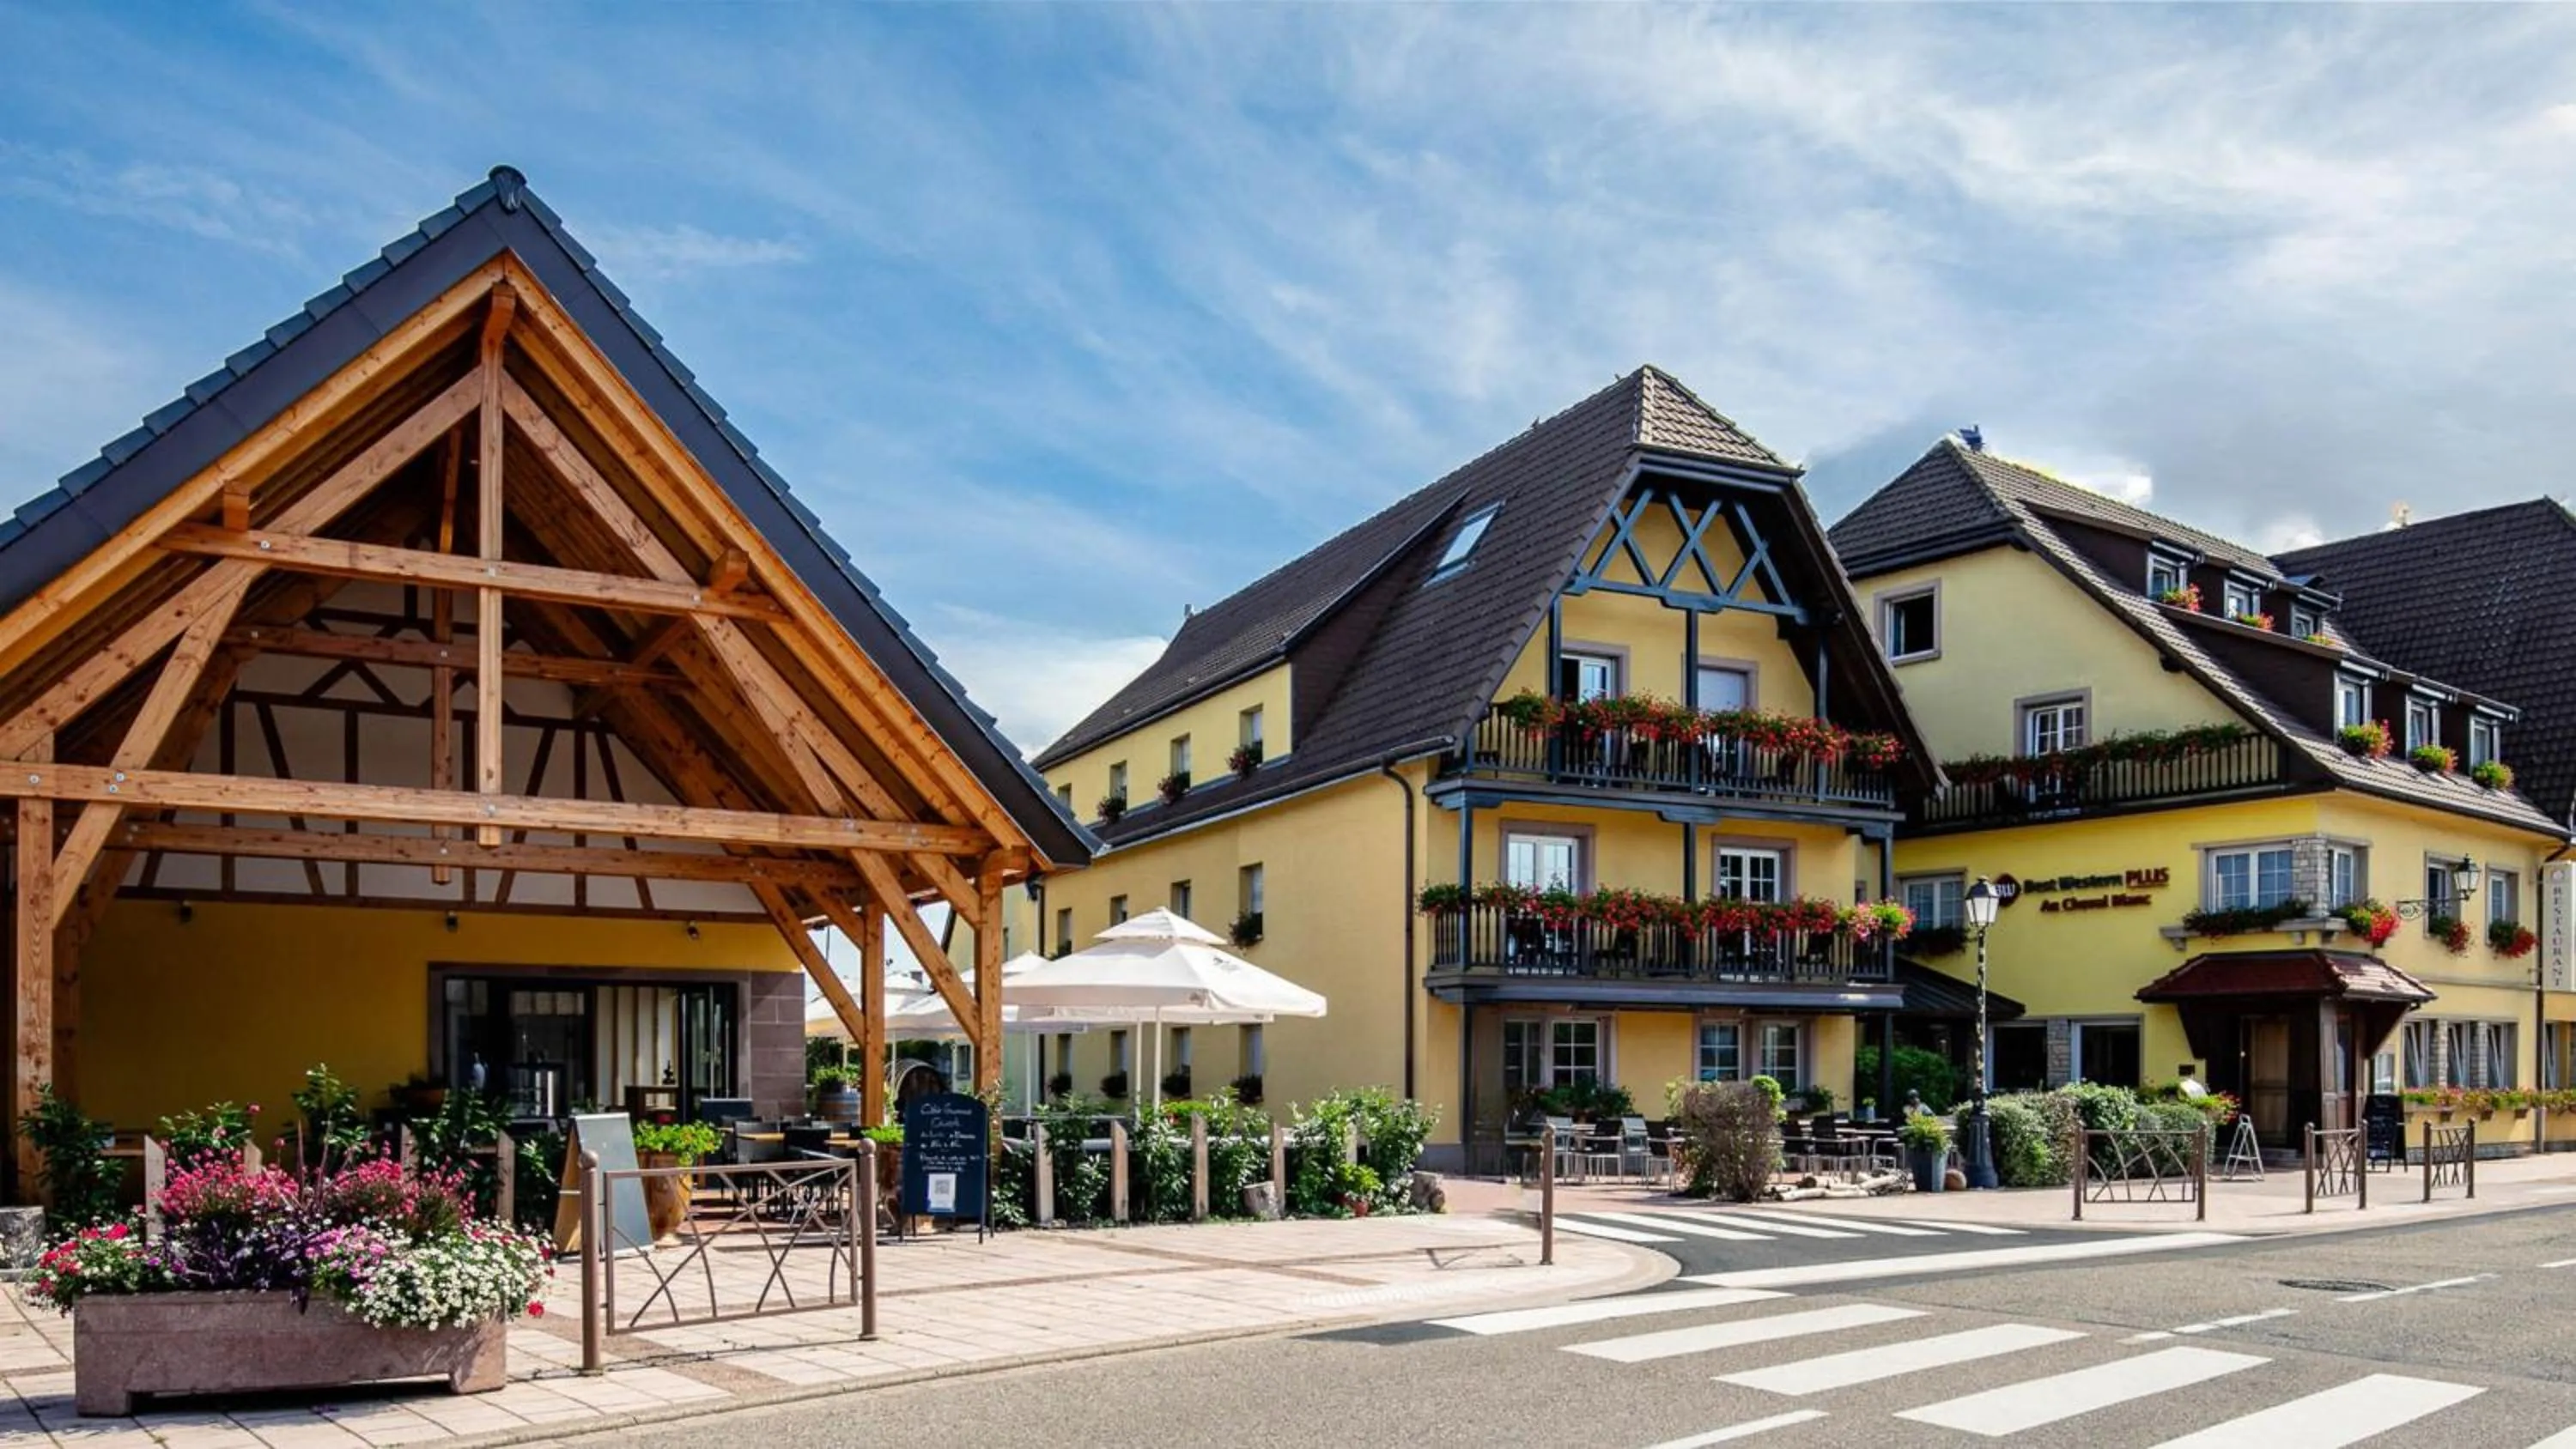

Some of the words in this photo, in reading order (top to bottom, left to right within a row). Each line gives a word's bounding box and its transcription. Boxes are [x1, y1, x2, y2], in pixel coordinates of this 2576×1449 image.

[2023, 879, 2057, 894] Best
[2059, 875, 2123, 889] Western
[2125, 867, 2169, 886] PLUS
[2040, 899, 2059, 912] Au
[2553, 886, 2563, 986] RESTAURANT
